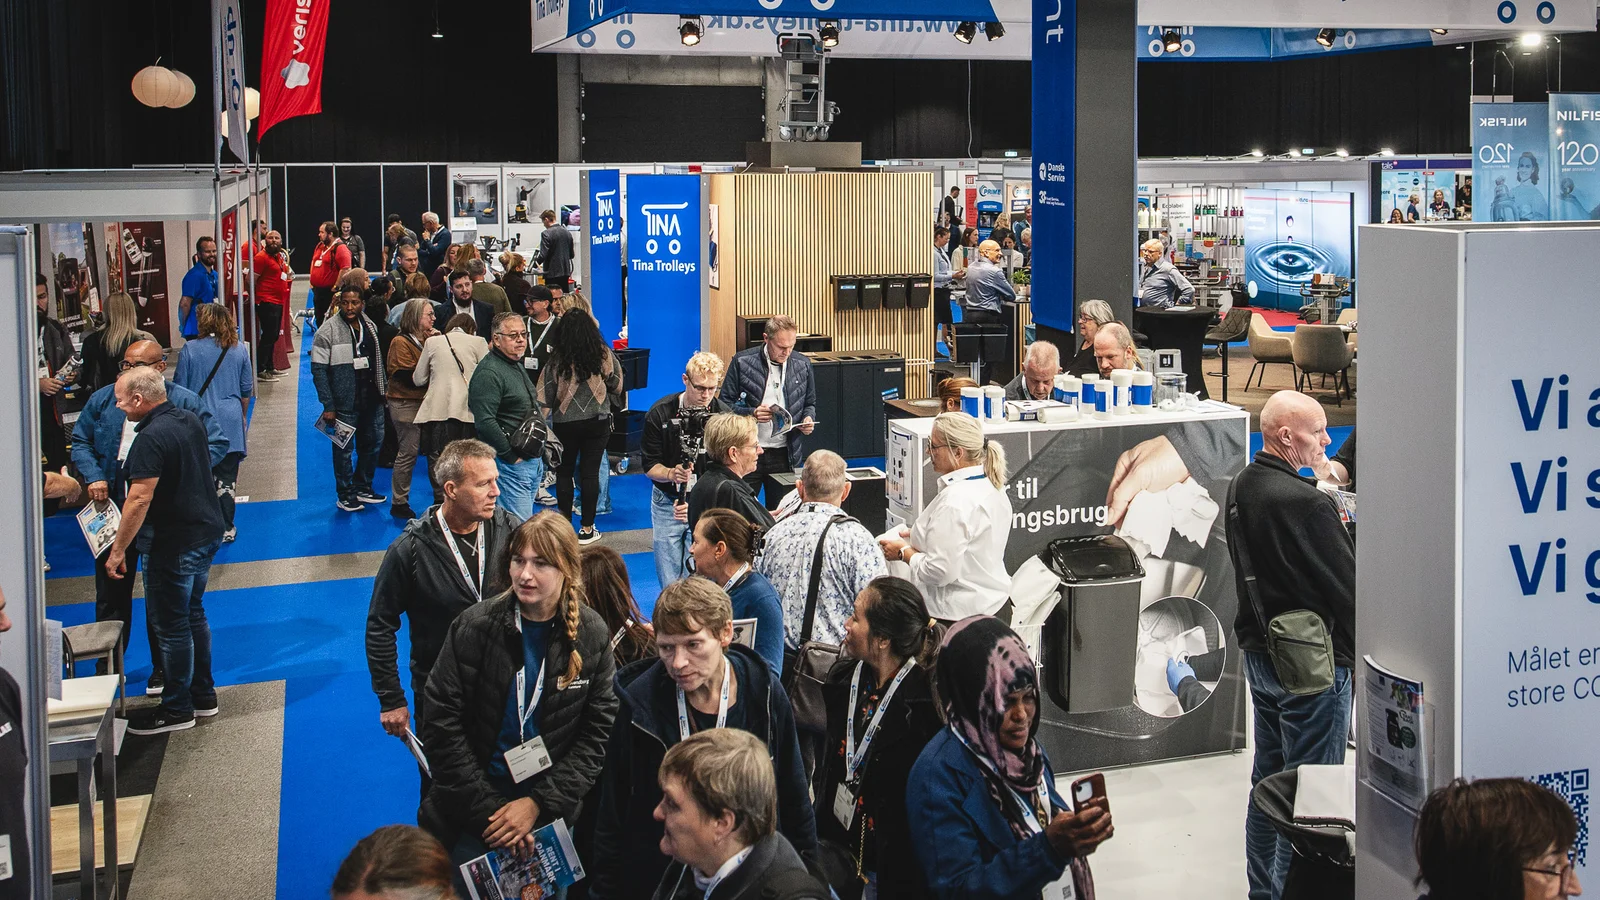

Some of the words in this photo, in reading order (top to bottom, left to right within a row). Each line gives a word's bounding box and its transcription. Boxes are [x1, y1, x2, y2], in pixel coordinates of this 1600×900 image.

[1557, 141, 1599, 166] 120
[1048, 173, 1065, 182] Service
[641, 201, 689, 236] TINA
[592, 235, 602, 245] Tina
[602, 233, 619, 243] Trolleys
[632, 259, 654, 271] Tina
[655, 259, 696, 274] Trolleys
[1511, 374, 1569, 431] Vi
[1016, 477, 1038, 499] til
[1510, 456, 1567, 514] Vi
[1509, 538, 1566, 596] Vi
[1508, 646, 1571, 674] Målet
[1508, 685, 1565, 708] store
[535, 842, 556, 883] DANMARK
[546, 846, 559, 867] RENT
